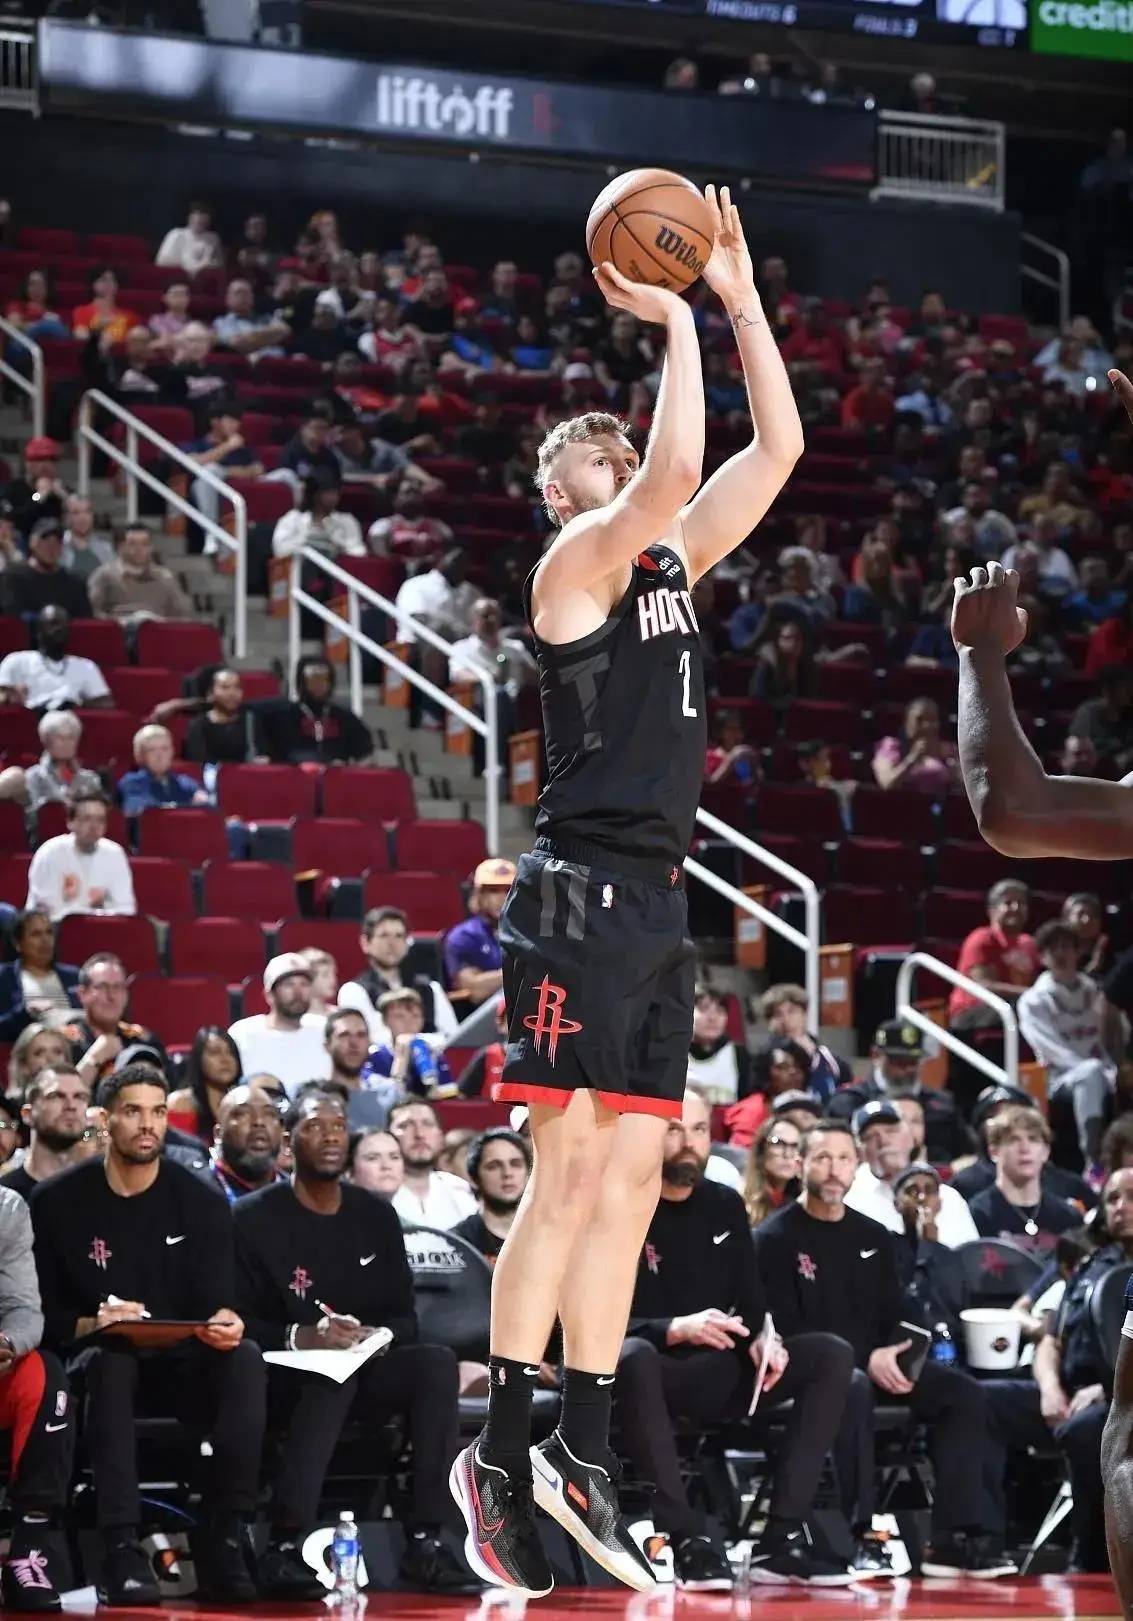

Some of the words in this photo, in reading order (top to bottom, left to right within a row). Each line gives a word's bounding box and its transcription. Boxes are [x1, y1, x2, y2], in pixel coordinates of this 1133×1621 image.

[377, 75, 513, 138] liftoff
[655, 224, 704, 275] Wilso
[678, 650, 698, 718] 2
